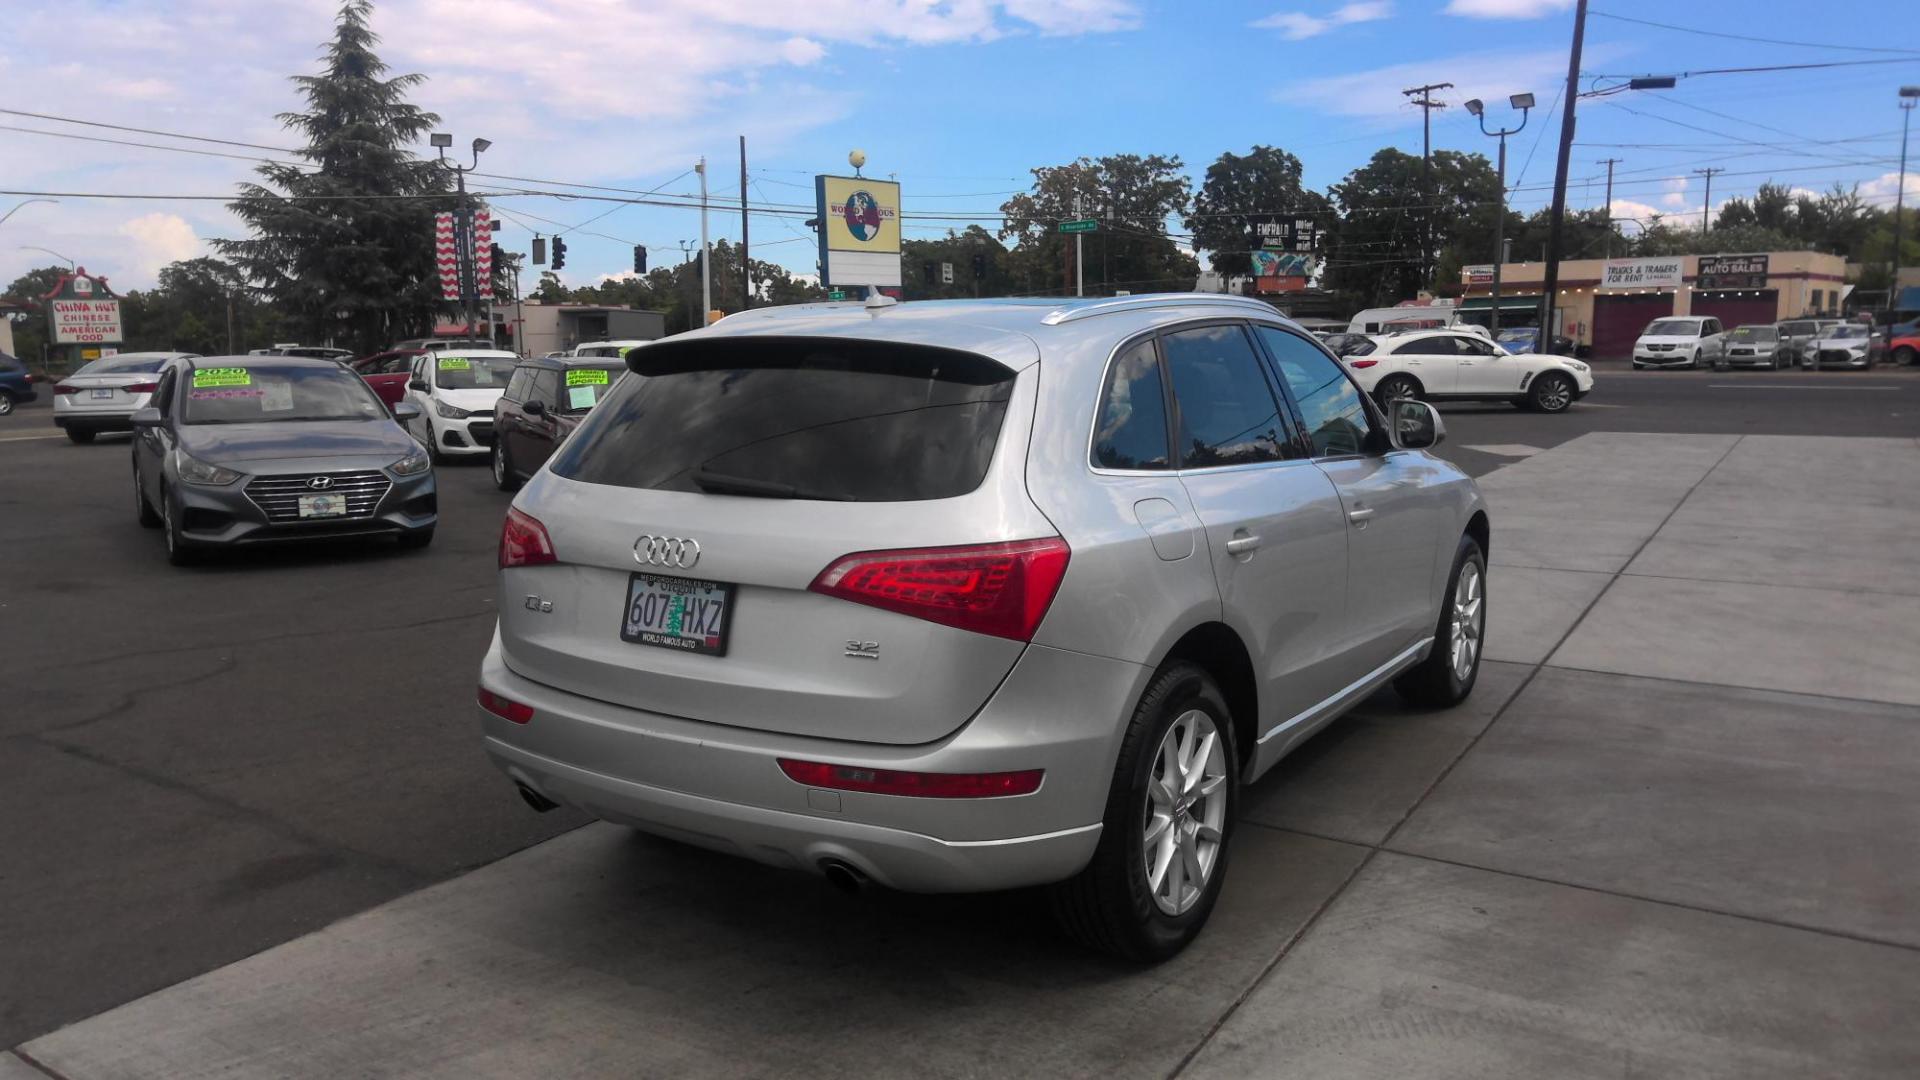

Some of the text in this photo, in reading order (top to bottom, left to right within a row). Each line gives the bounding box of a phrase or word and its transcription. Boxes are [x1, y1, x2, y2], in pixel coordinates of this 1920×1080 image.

[831, 205, 860, 215] WOD
[1257, 223, 1289, 235] EMERALD
[1608, 264, 1678, 274] TRUCKS & TRAILERS
[1703, 263, 1763, 274] AUTO SALES
[1624, 274, 1643, 282] RENT
[55, 303, 116, 312] CHINA HUT
[64, 314, 111, 322] CHINESE
[195, 368, 246, 376] 2020
[630, 592, 723, 636] 607 HXZ
[643, 633, 696, 649] WORLD FAMOUS AUTO
